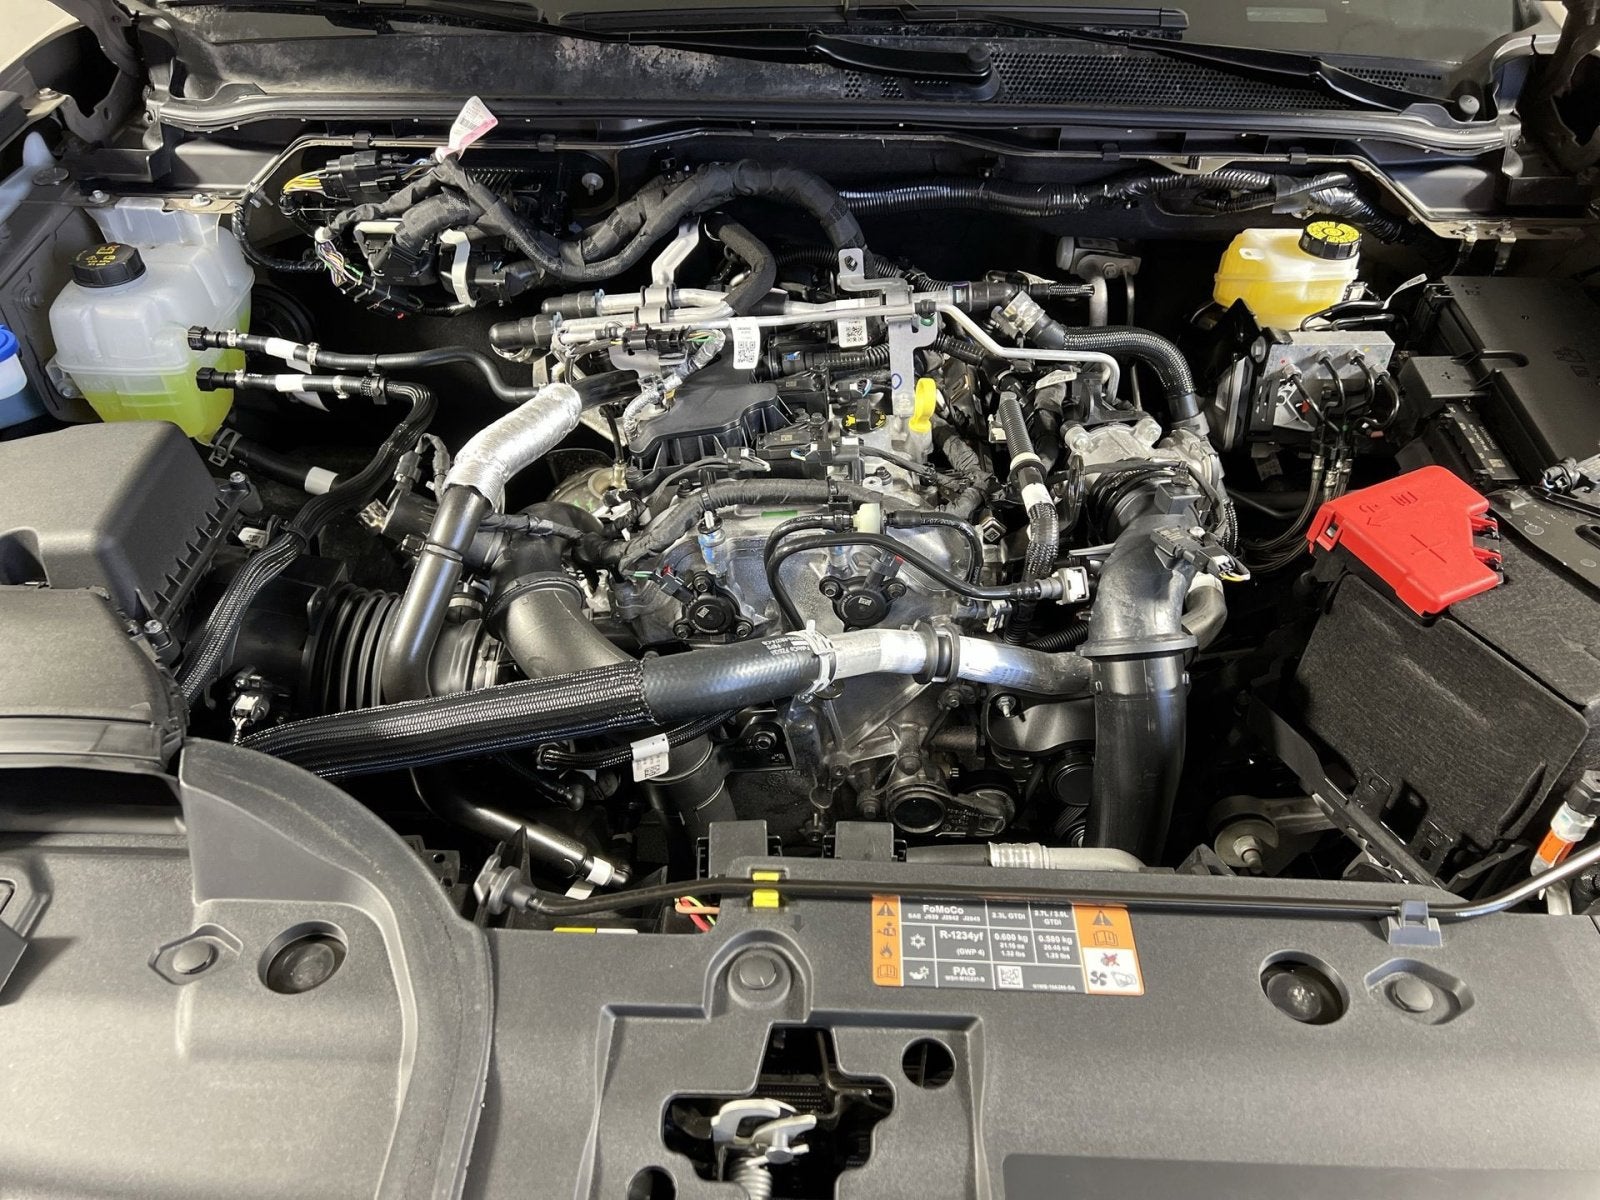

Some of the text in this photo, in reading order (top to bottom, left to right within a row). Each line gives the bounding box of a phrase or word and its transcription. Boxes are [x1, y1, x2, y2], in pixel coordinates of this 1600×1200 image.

[922, 905, 964, 915] FoMoCo
[940, 930, 983, 942] R-1234yf
[1018, 934, 1028, 943] kg
[952, 966, 976, 975] PAG
